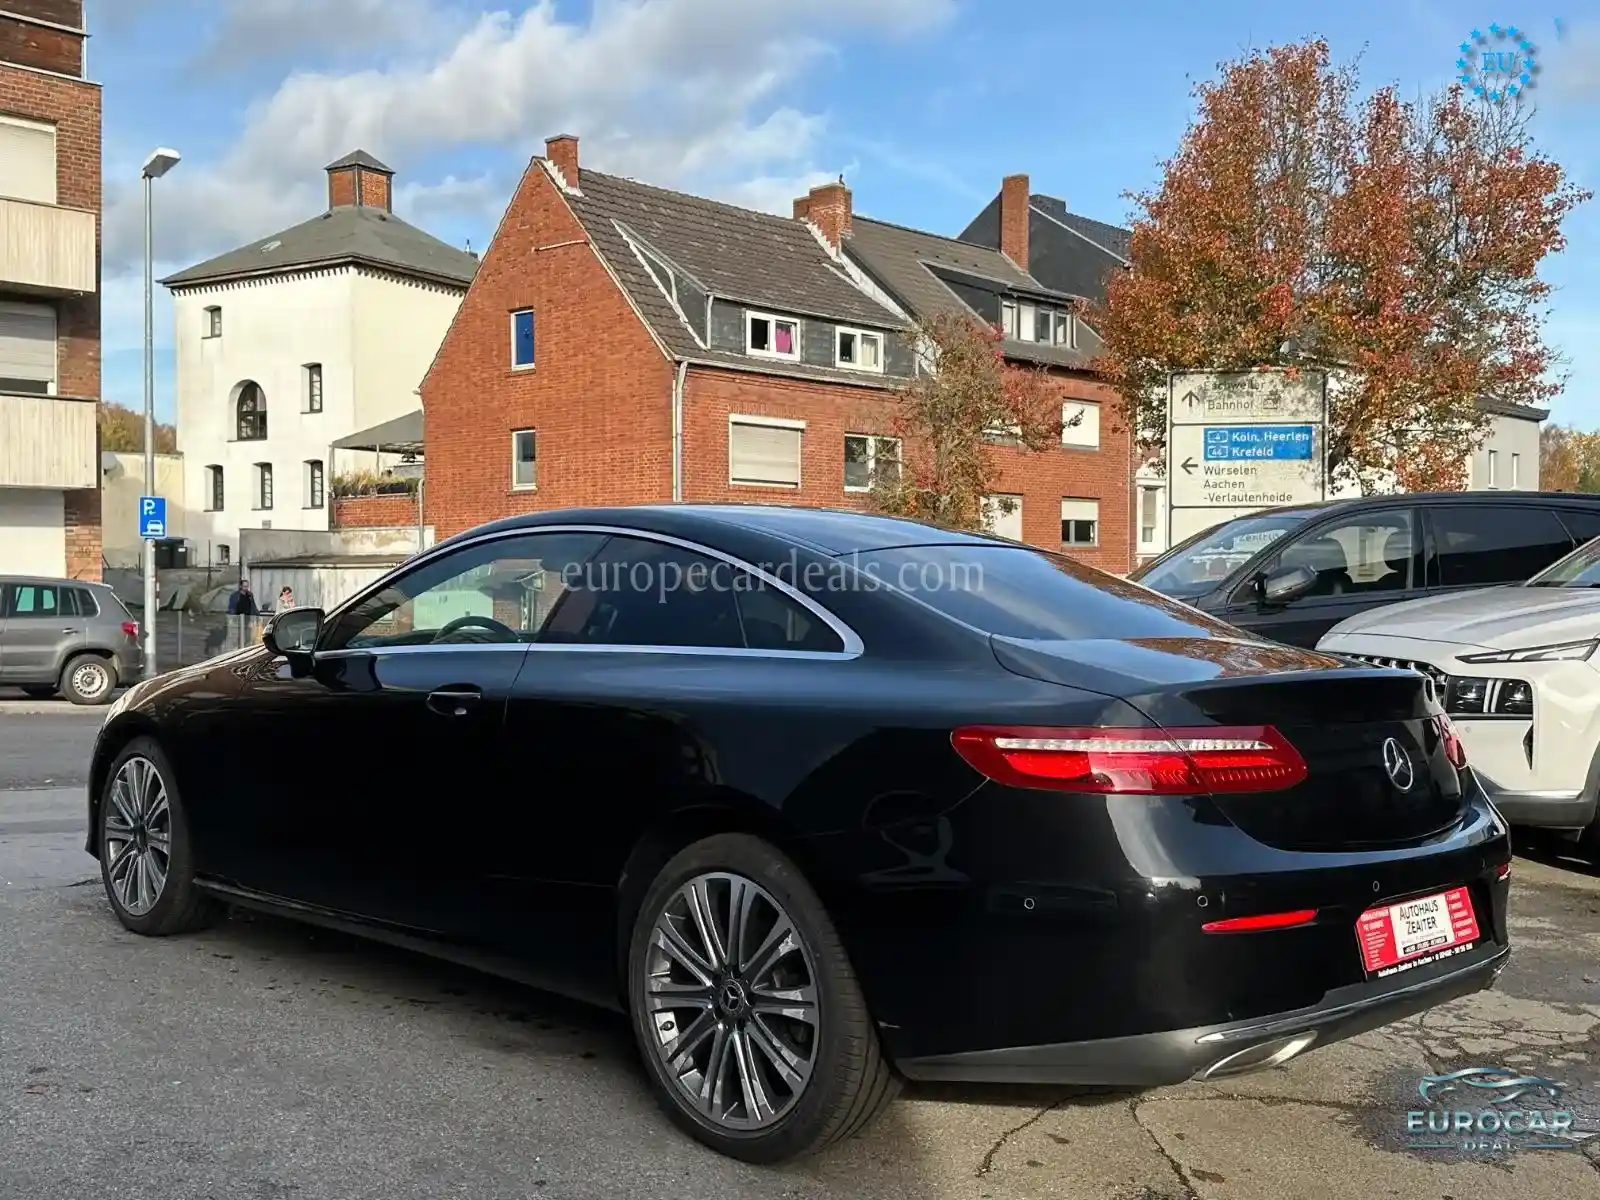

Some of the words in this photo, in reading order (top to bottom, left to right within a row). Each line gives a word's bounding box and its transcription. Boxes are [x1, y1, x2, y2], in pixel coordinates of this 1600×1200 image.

[1208, 399, 1253, 410] Bahnhof
[1264, 431, 1309, 441] Heerlen
[1232, 447, 1273, 457] Krefeld
[1204, 464, 1257, 476] Würselen
[1204, 479, 1245, 489] Aachen
[1400, 899, 1439, 921] AUTOHAUS
[1405, 916, 1438, 935] ZEAITER
